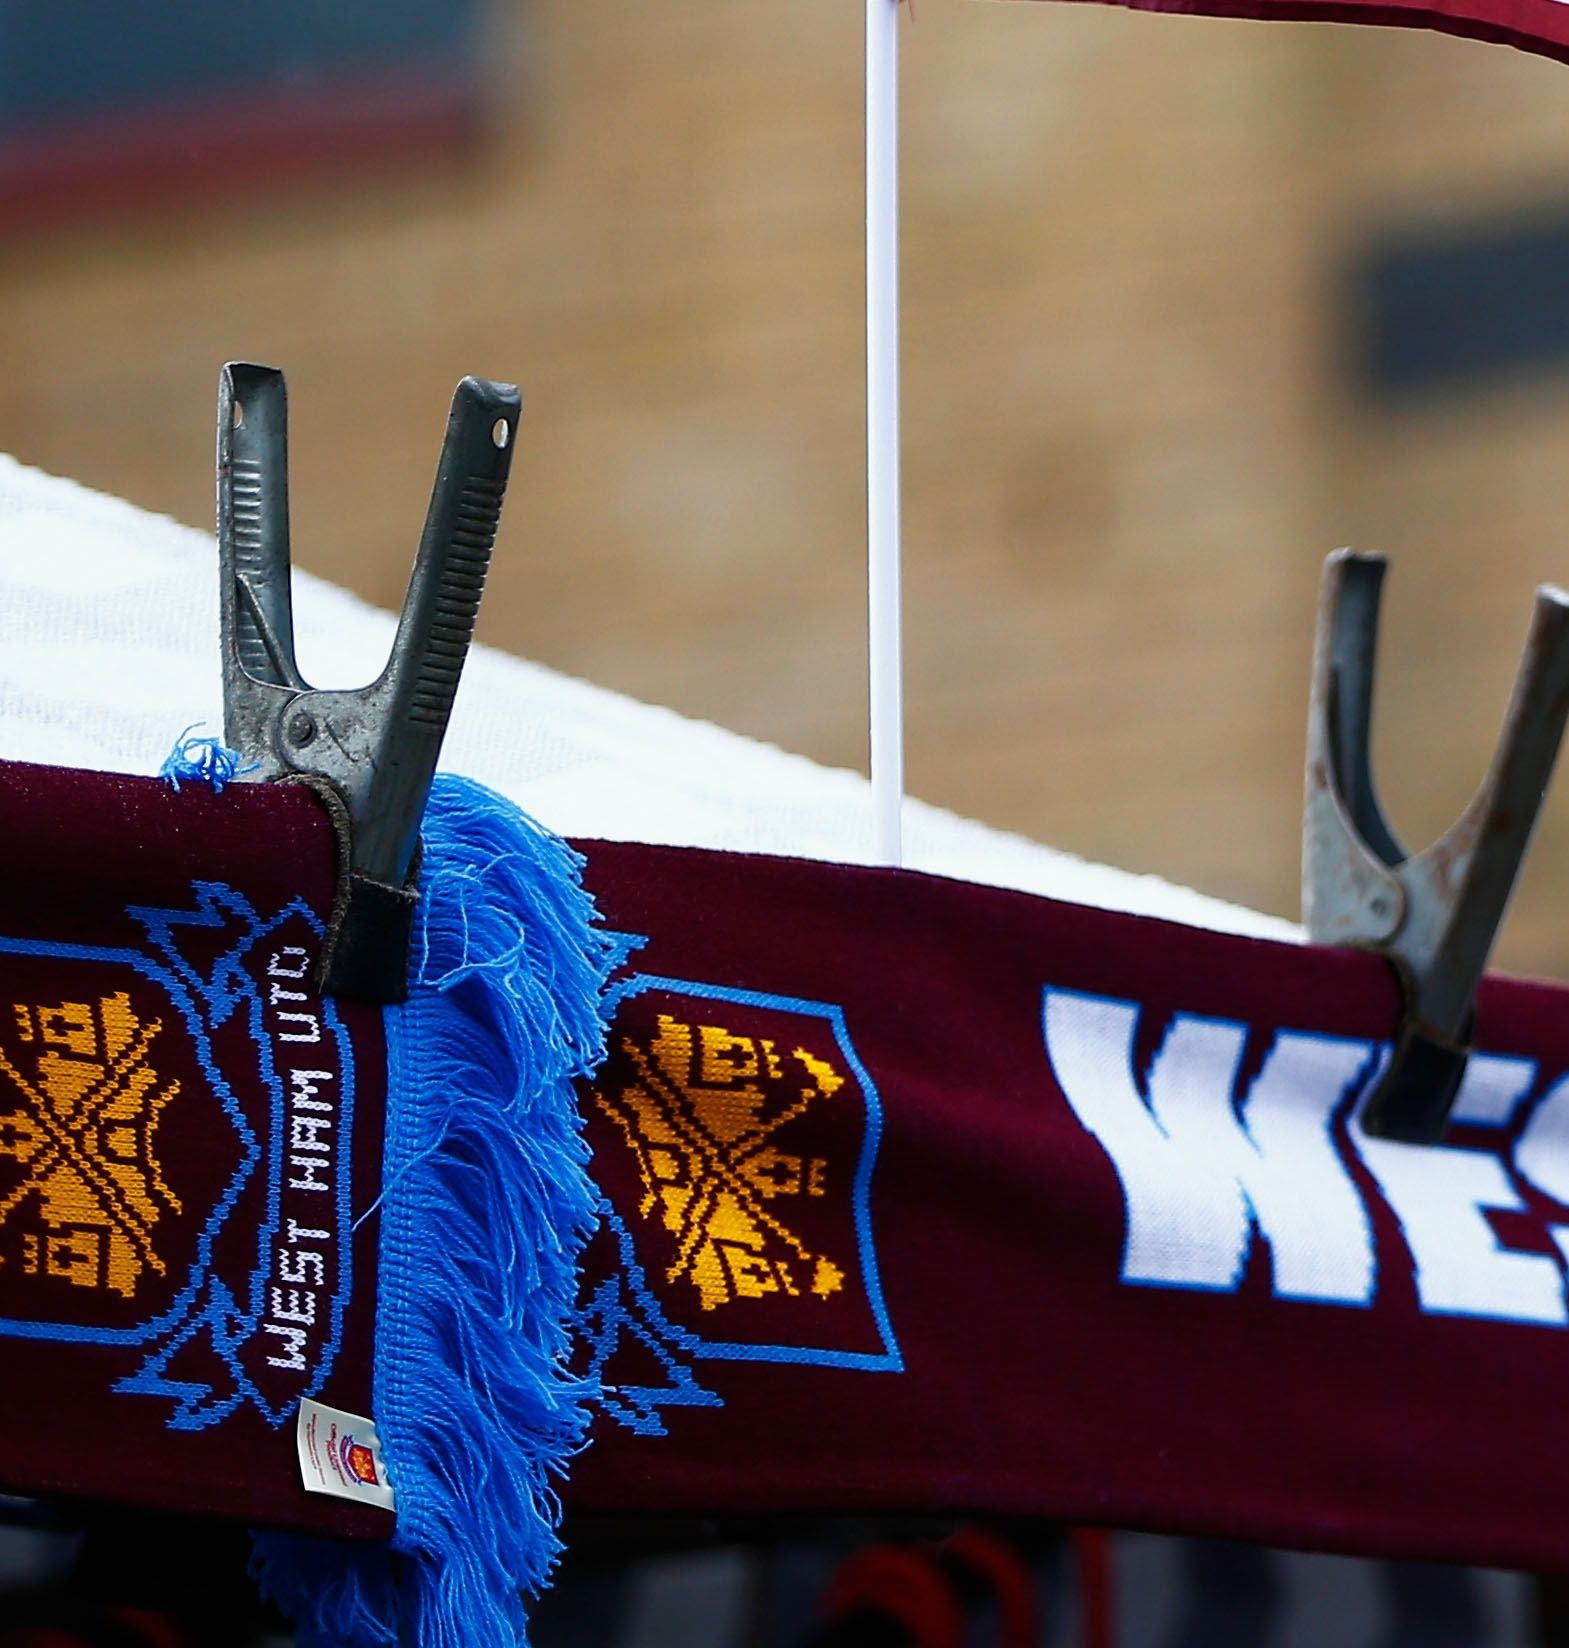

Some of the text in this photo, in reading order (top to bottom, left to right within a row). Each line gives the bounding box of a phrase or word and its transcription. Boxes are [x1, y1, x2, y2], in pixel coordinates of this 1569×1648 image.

[263, 946, 334, 1371] WEST HAM UTD
